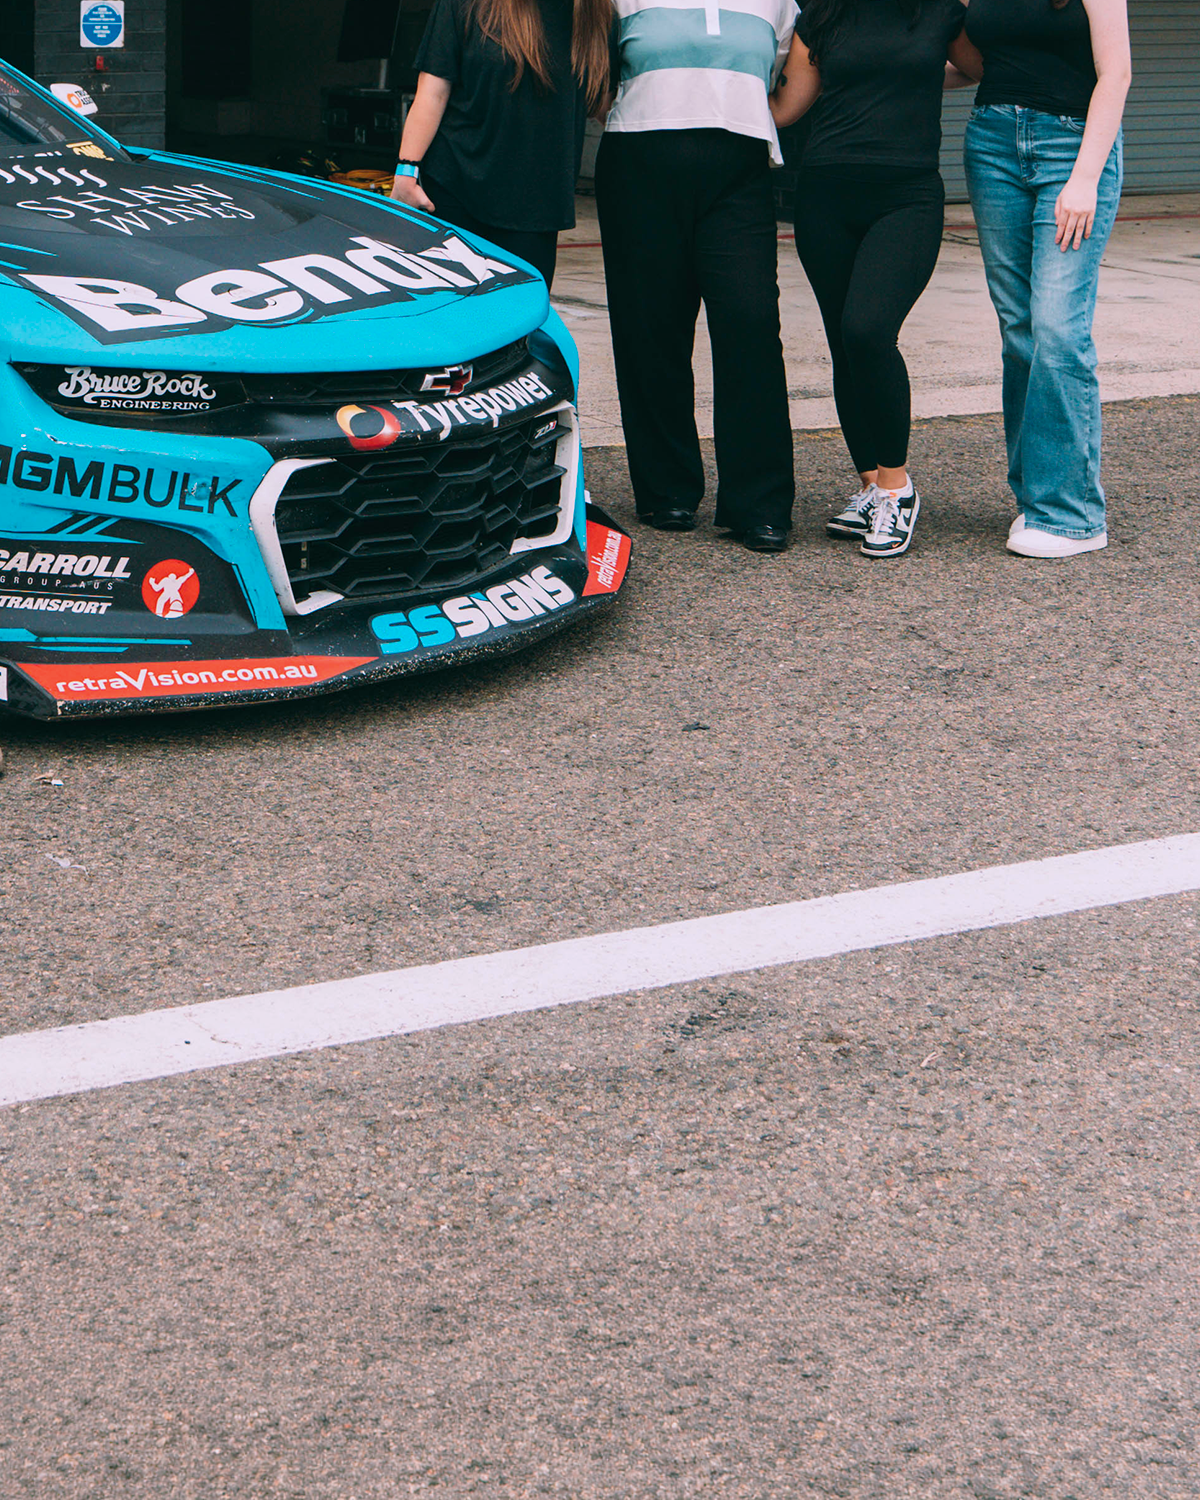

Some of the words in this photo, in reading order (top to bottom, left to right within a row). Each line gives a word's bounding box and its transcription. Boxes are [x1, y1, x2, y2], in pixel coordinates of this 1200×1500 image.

[16, 183, 234, 219] SHAW
[90, 201, 256, 236] WINES
[19, 236, 517, 332] Bendix
[58, 366, 142, 399] Bruce
[141, 370, 217, 400] Rock
[100, 399, 210, 410] ENGINEERING
[393, 371, 553, 442] Tyrepower
[597, 530, 623, 588] retraVision.com.au
[0, 575, 62, 587] GROUP
[79, 581, 114, 590] AUS
[371, 565, 575, 654] SSSIGNS
[56, 662, 318, 692] retraVision.com.au
